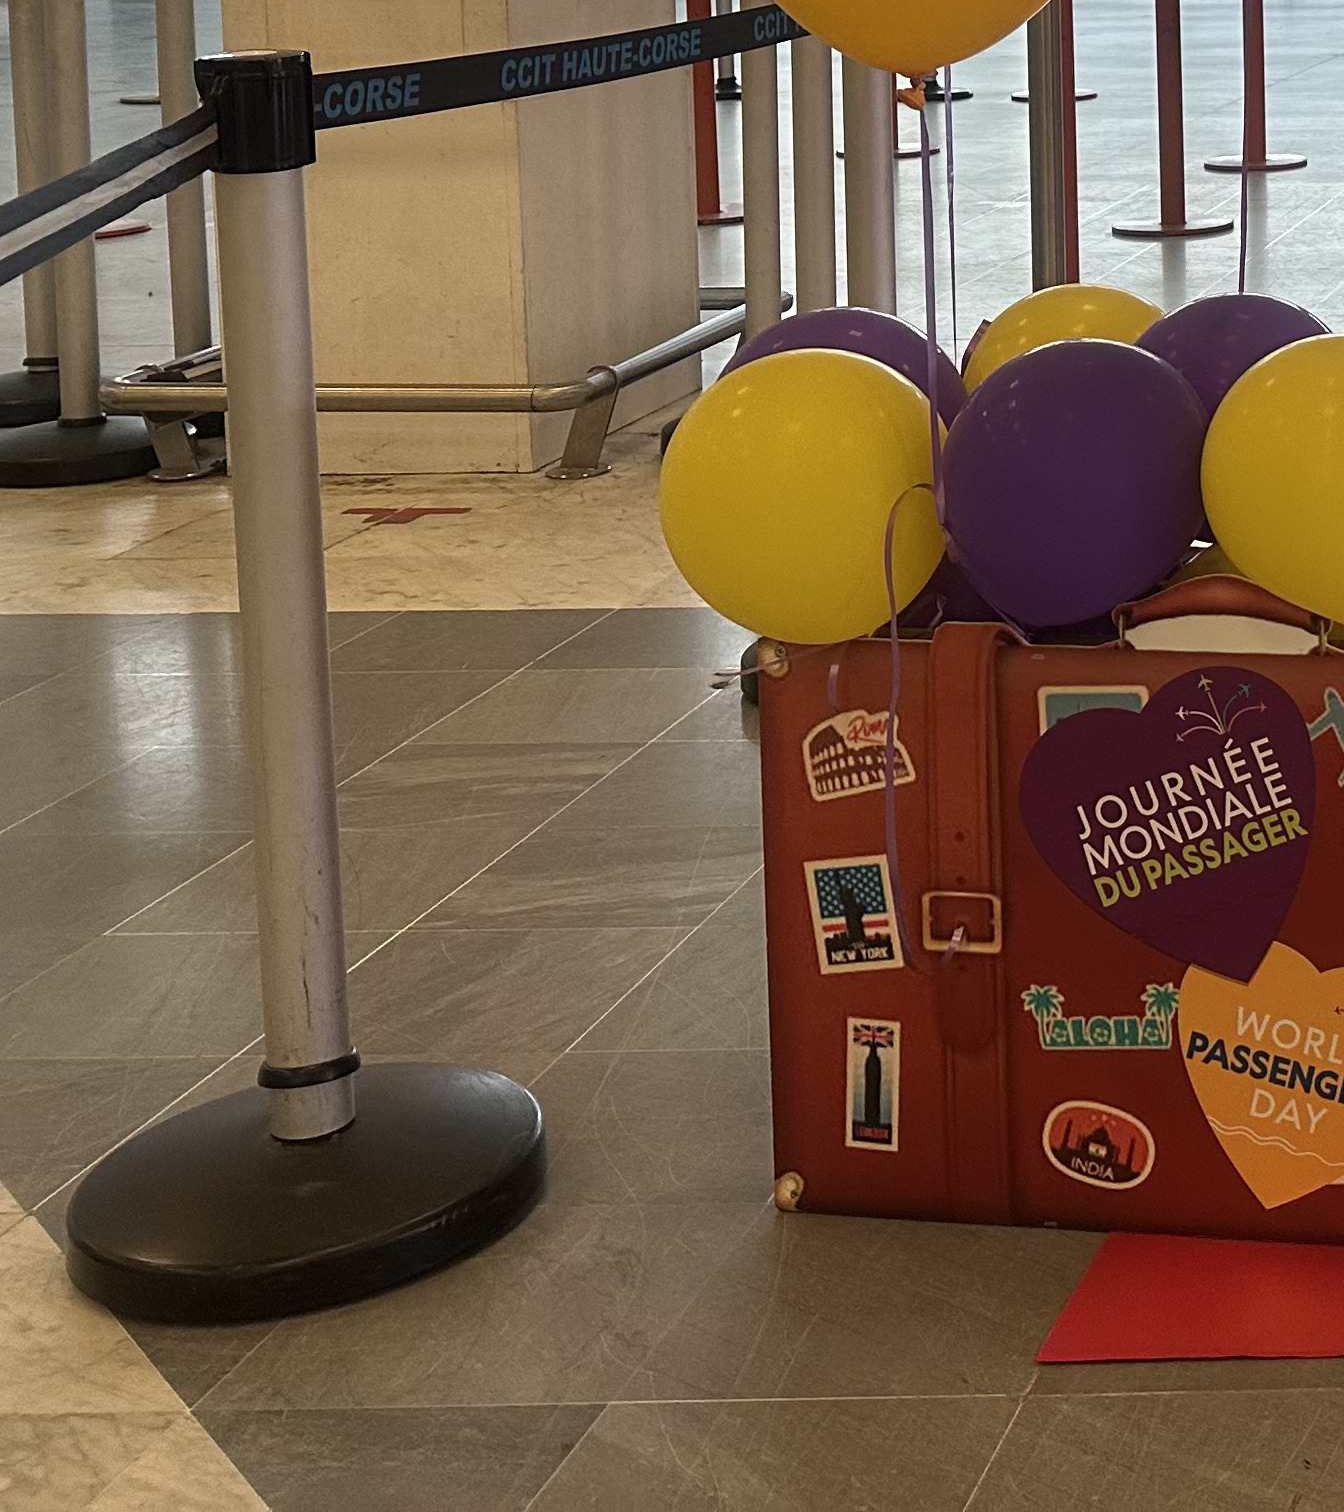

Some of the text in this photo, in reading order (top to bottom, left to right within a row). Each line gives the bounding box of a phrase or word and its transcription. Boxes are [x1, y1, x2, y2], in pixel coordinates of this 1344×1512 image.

[501, 28, 702, 91] CCIT HAUTE-CORSE
[1077, 737, 1280, 840] JOURNÉE
[1083, 772, 1293, 876] MONDIALE
[1093, 808, 1309, 908] DU PASSAGER
[831, 947, 889, 963] NEW YORK
[1049, 1017, 1166, 1048] ALOHA
[1250, 1088, 1329, 1134] DAY
[1071, 1155, 1115, 1180] INDIA
